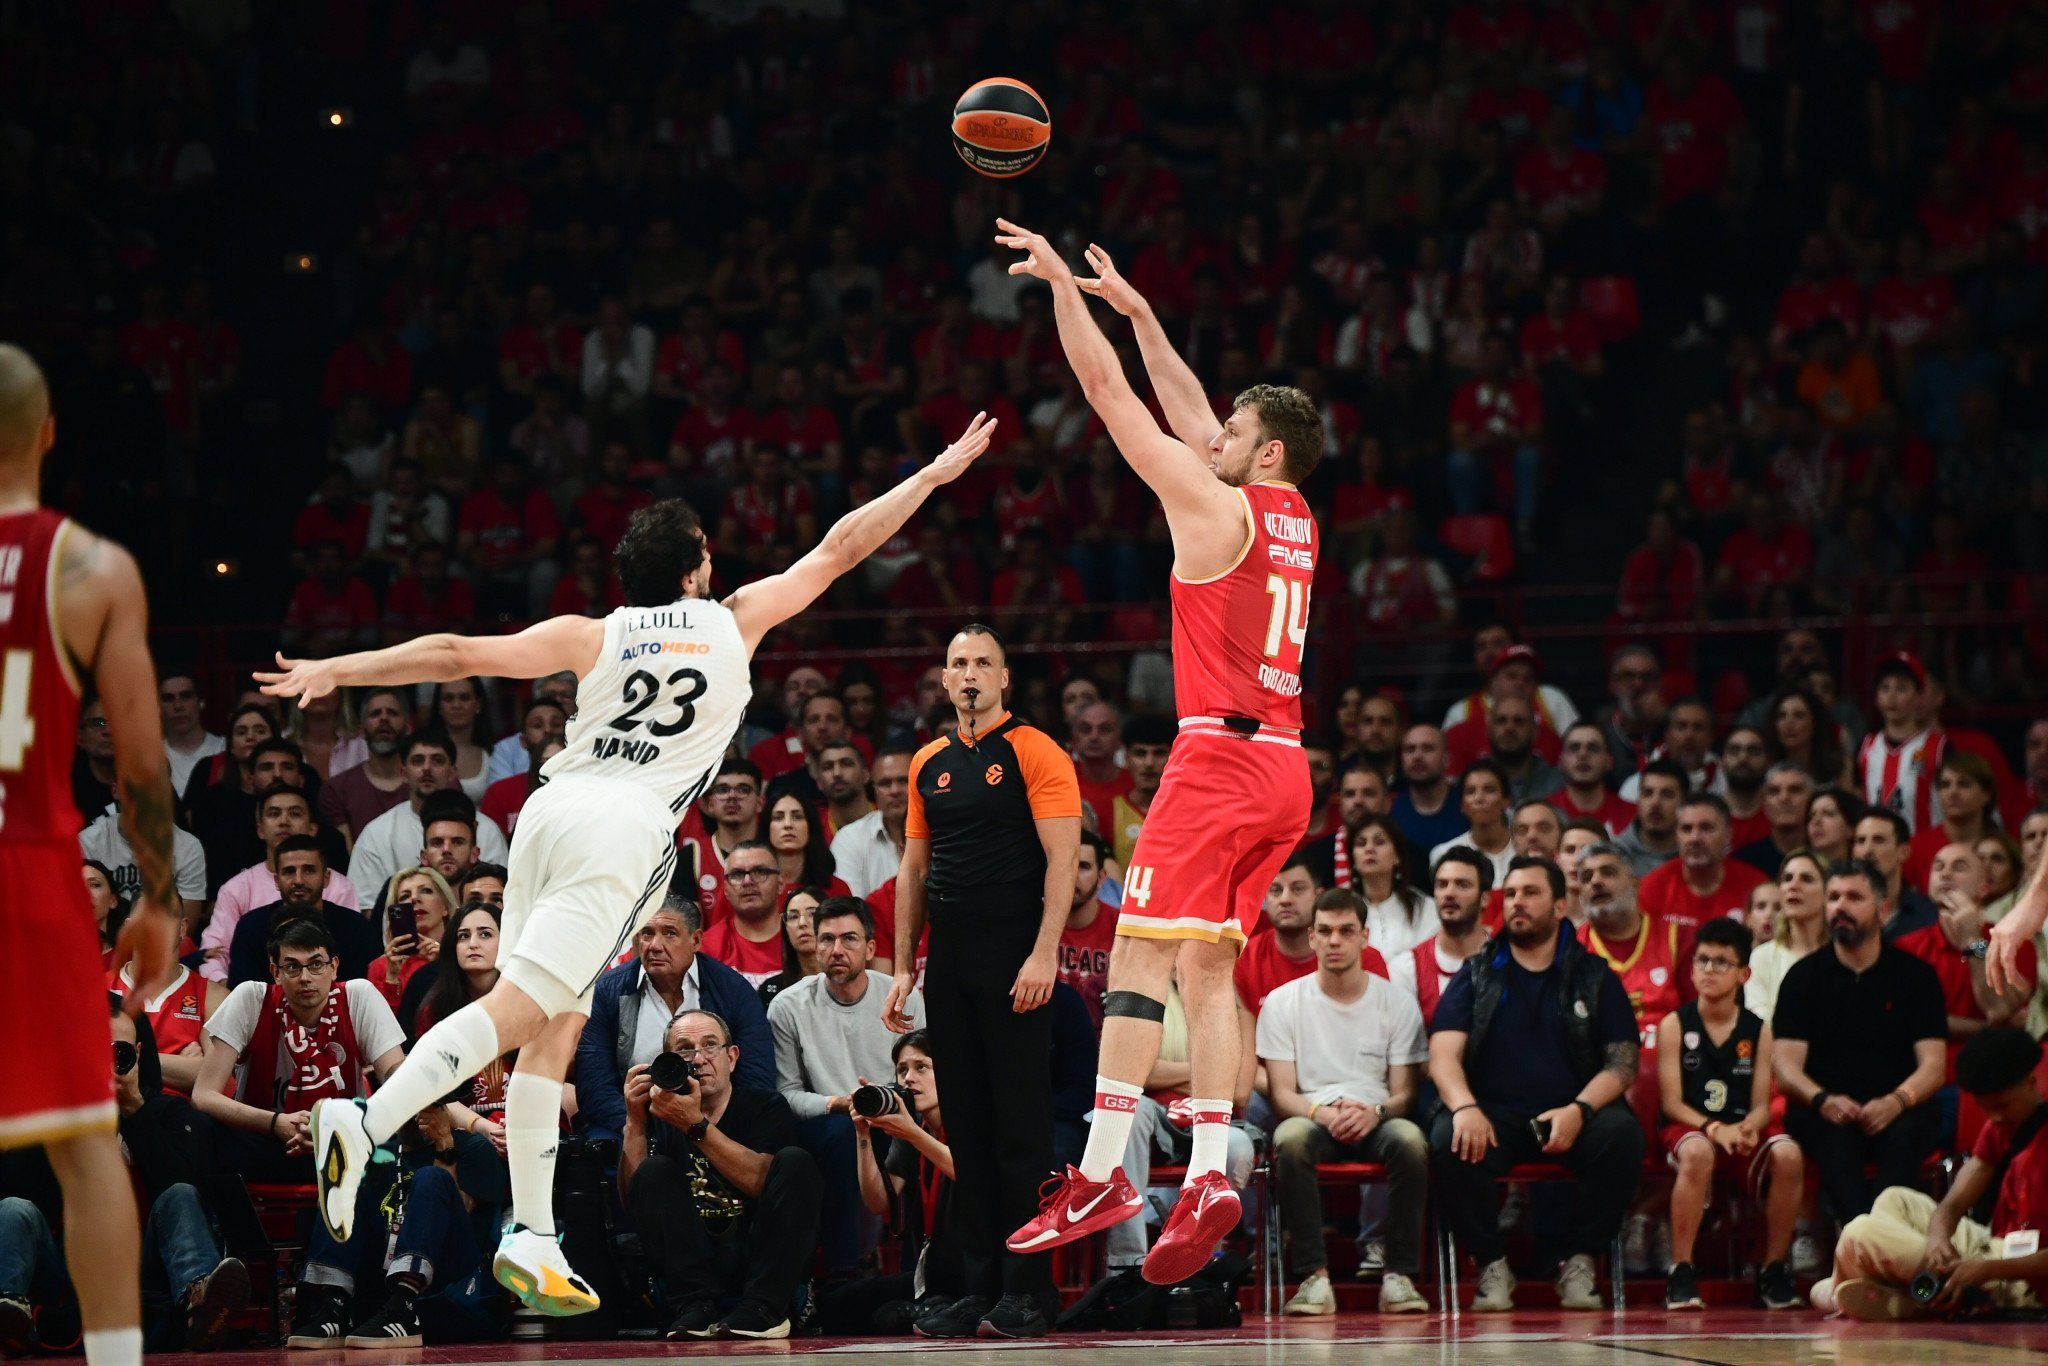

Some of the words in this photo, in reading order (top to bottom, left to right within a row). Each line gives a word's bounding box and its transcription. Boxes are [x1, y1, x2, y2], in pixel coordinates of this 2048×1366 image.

[1268, 544, 1313, 569] FMS
[1265, 573, 1311, 663] 14
[621, 642, 710, 662] AUTOHERO
[608, 668, 707, 737] 23
[1104, 1096, 1138, 1110] GSA
[1704, 1079, 1728, 1112] 3
